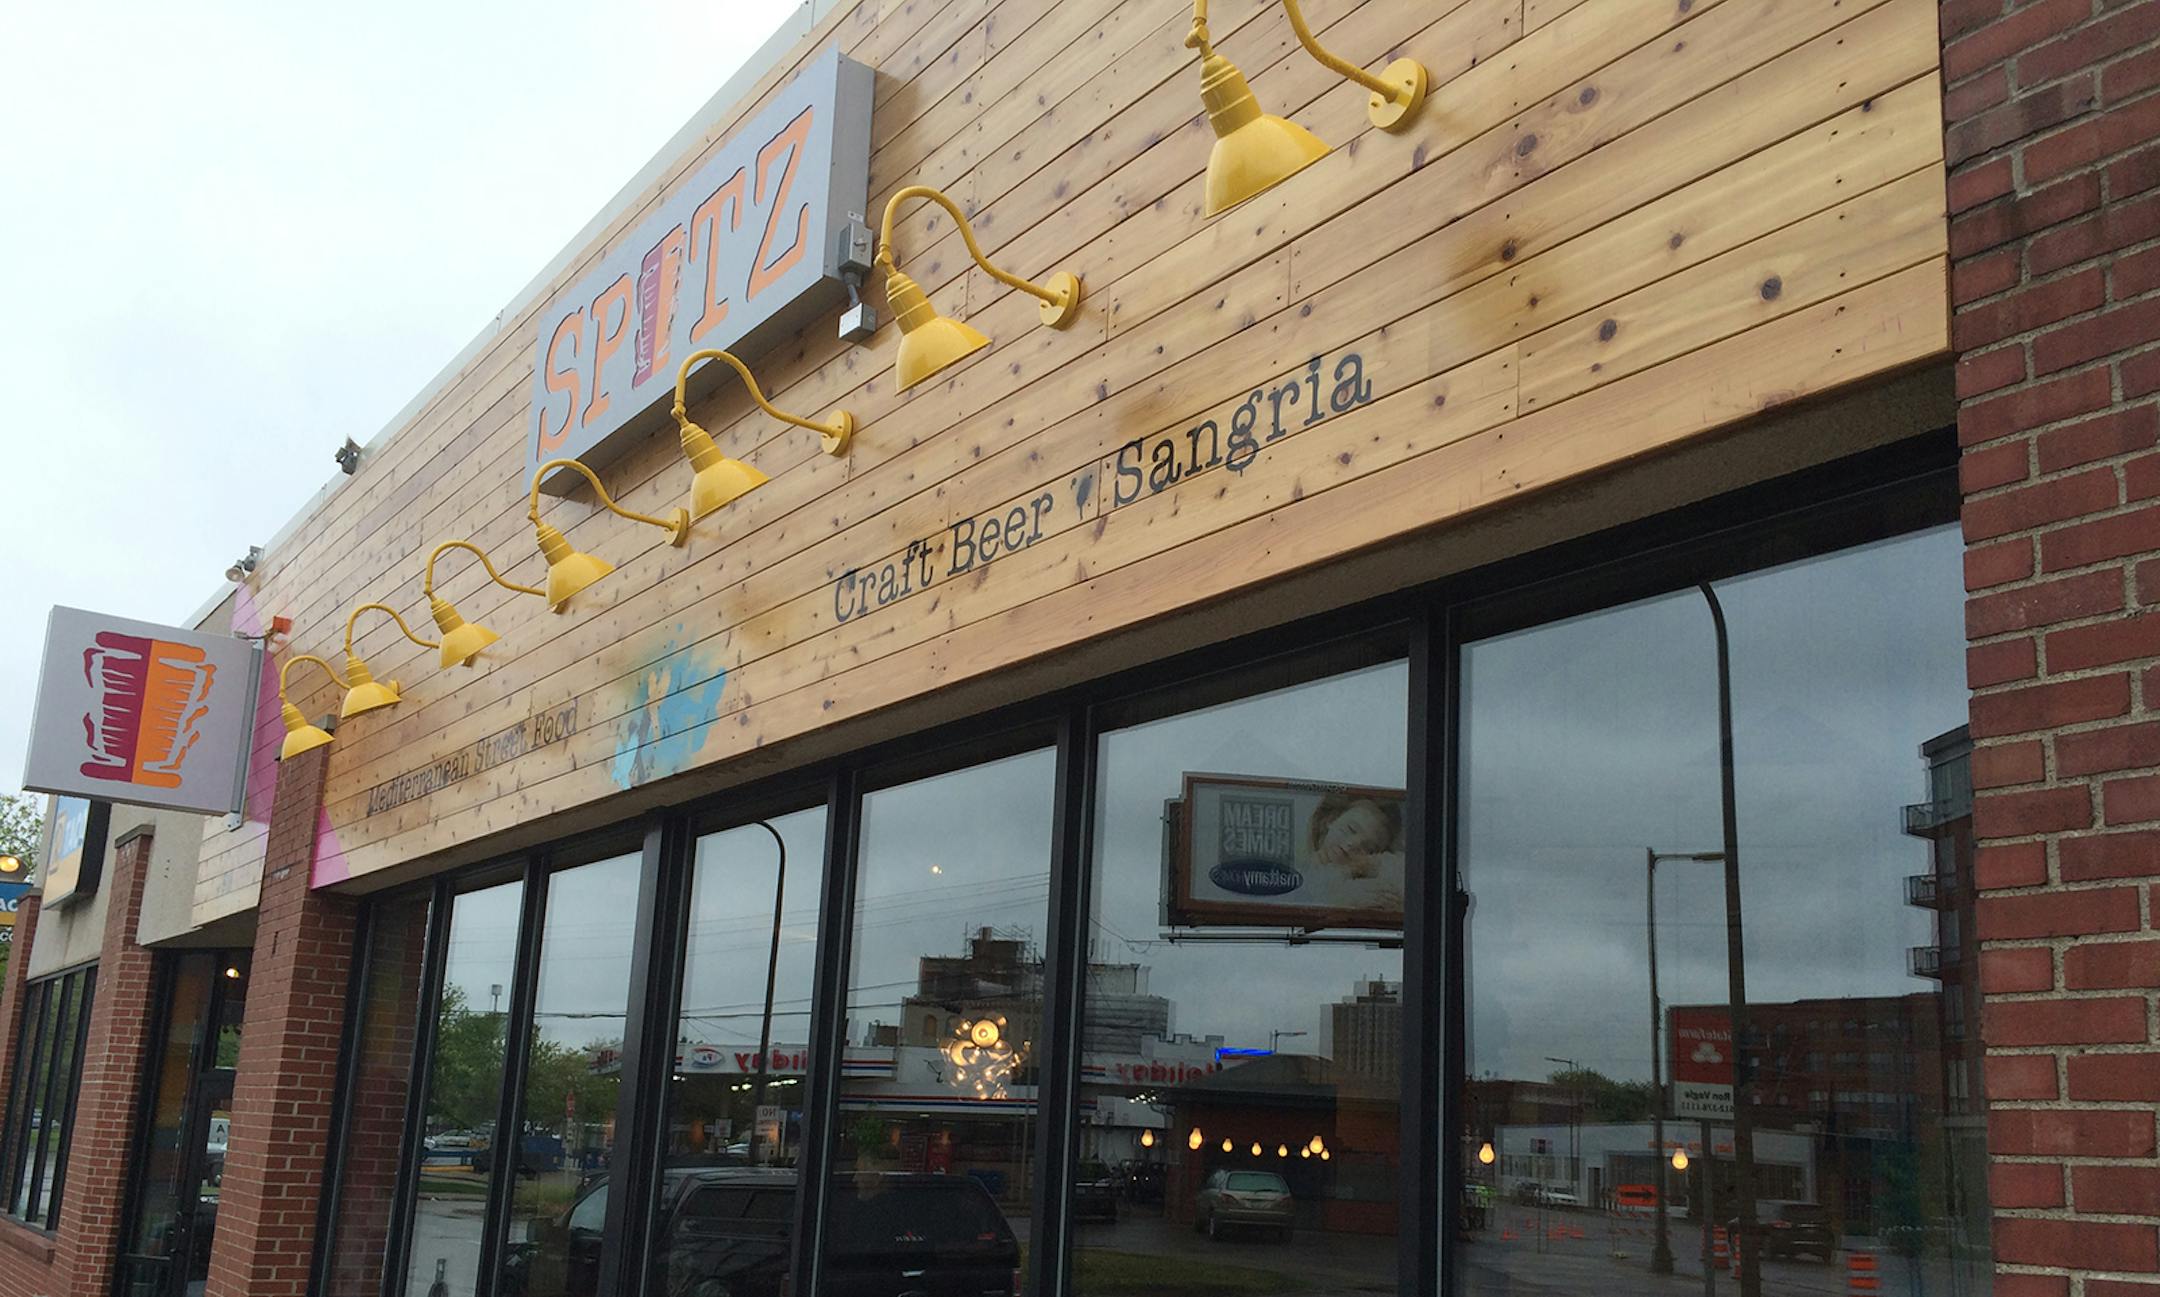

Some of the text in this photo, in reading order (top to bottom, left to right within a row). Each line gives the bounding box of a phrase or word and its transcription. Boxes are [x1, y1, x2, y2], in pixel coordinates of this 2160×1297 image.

[537, 104, 815, 462] SPITZ
[834, 353, 1372, 623] Craft Beer Sangria
[367, 699, 578, 817] Mediterranean Street Food
